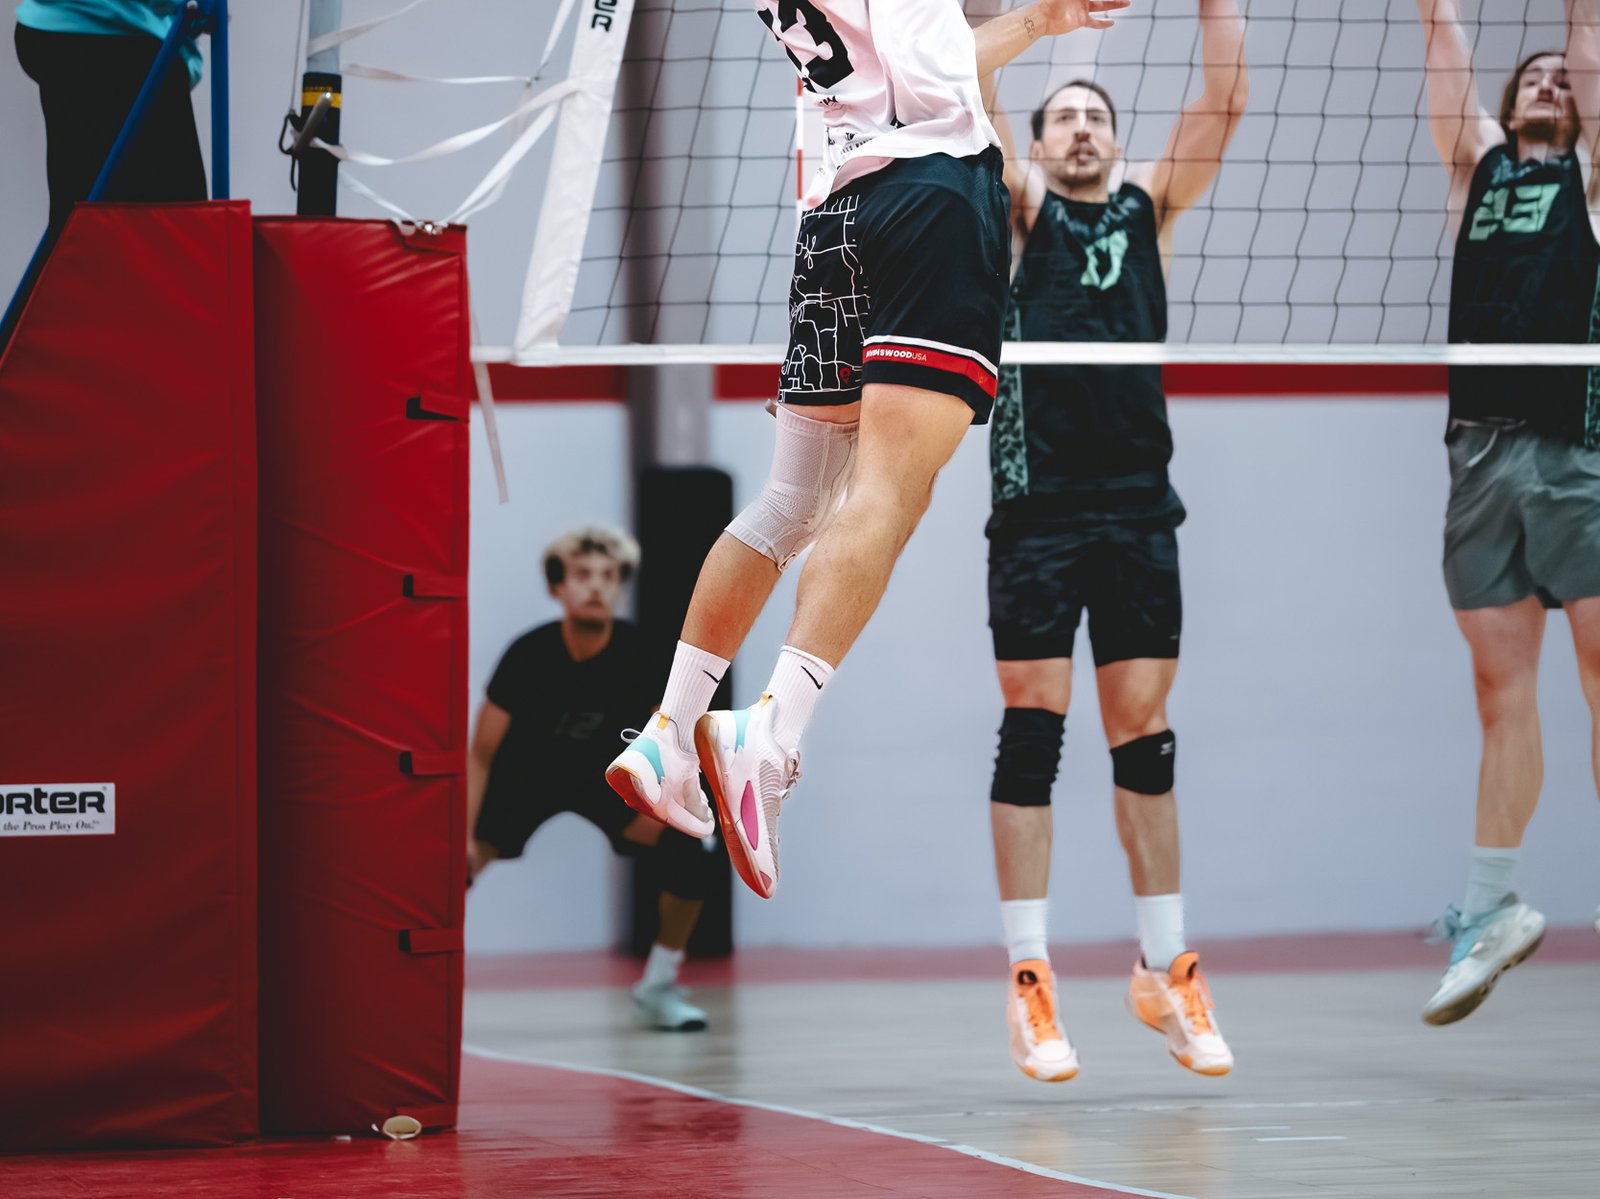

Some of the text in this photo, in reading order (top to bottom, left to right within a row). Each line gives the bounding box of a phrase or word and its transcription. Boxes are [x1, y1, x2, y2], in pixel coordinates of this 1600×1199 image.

[1468, 183, 1561, 240] 23
[23, 821, 46, 830] Pros
[49, 821, 72, 832] Play
